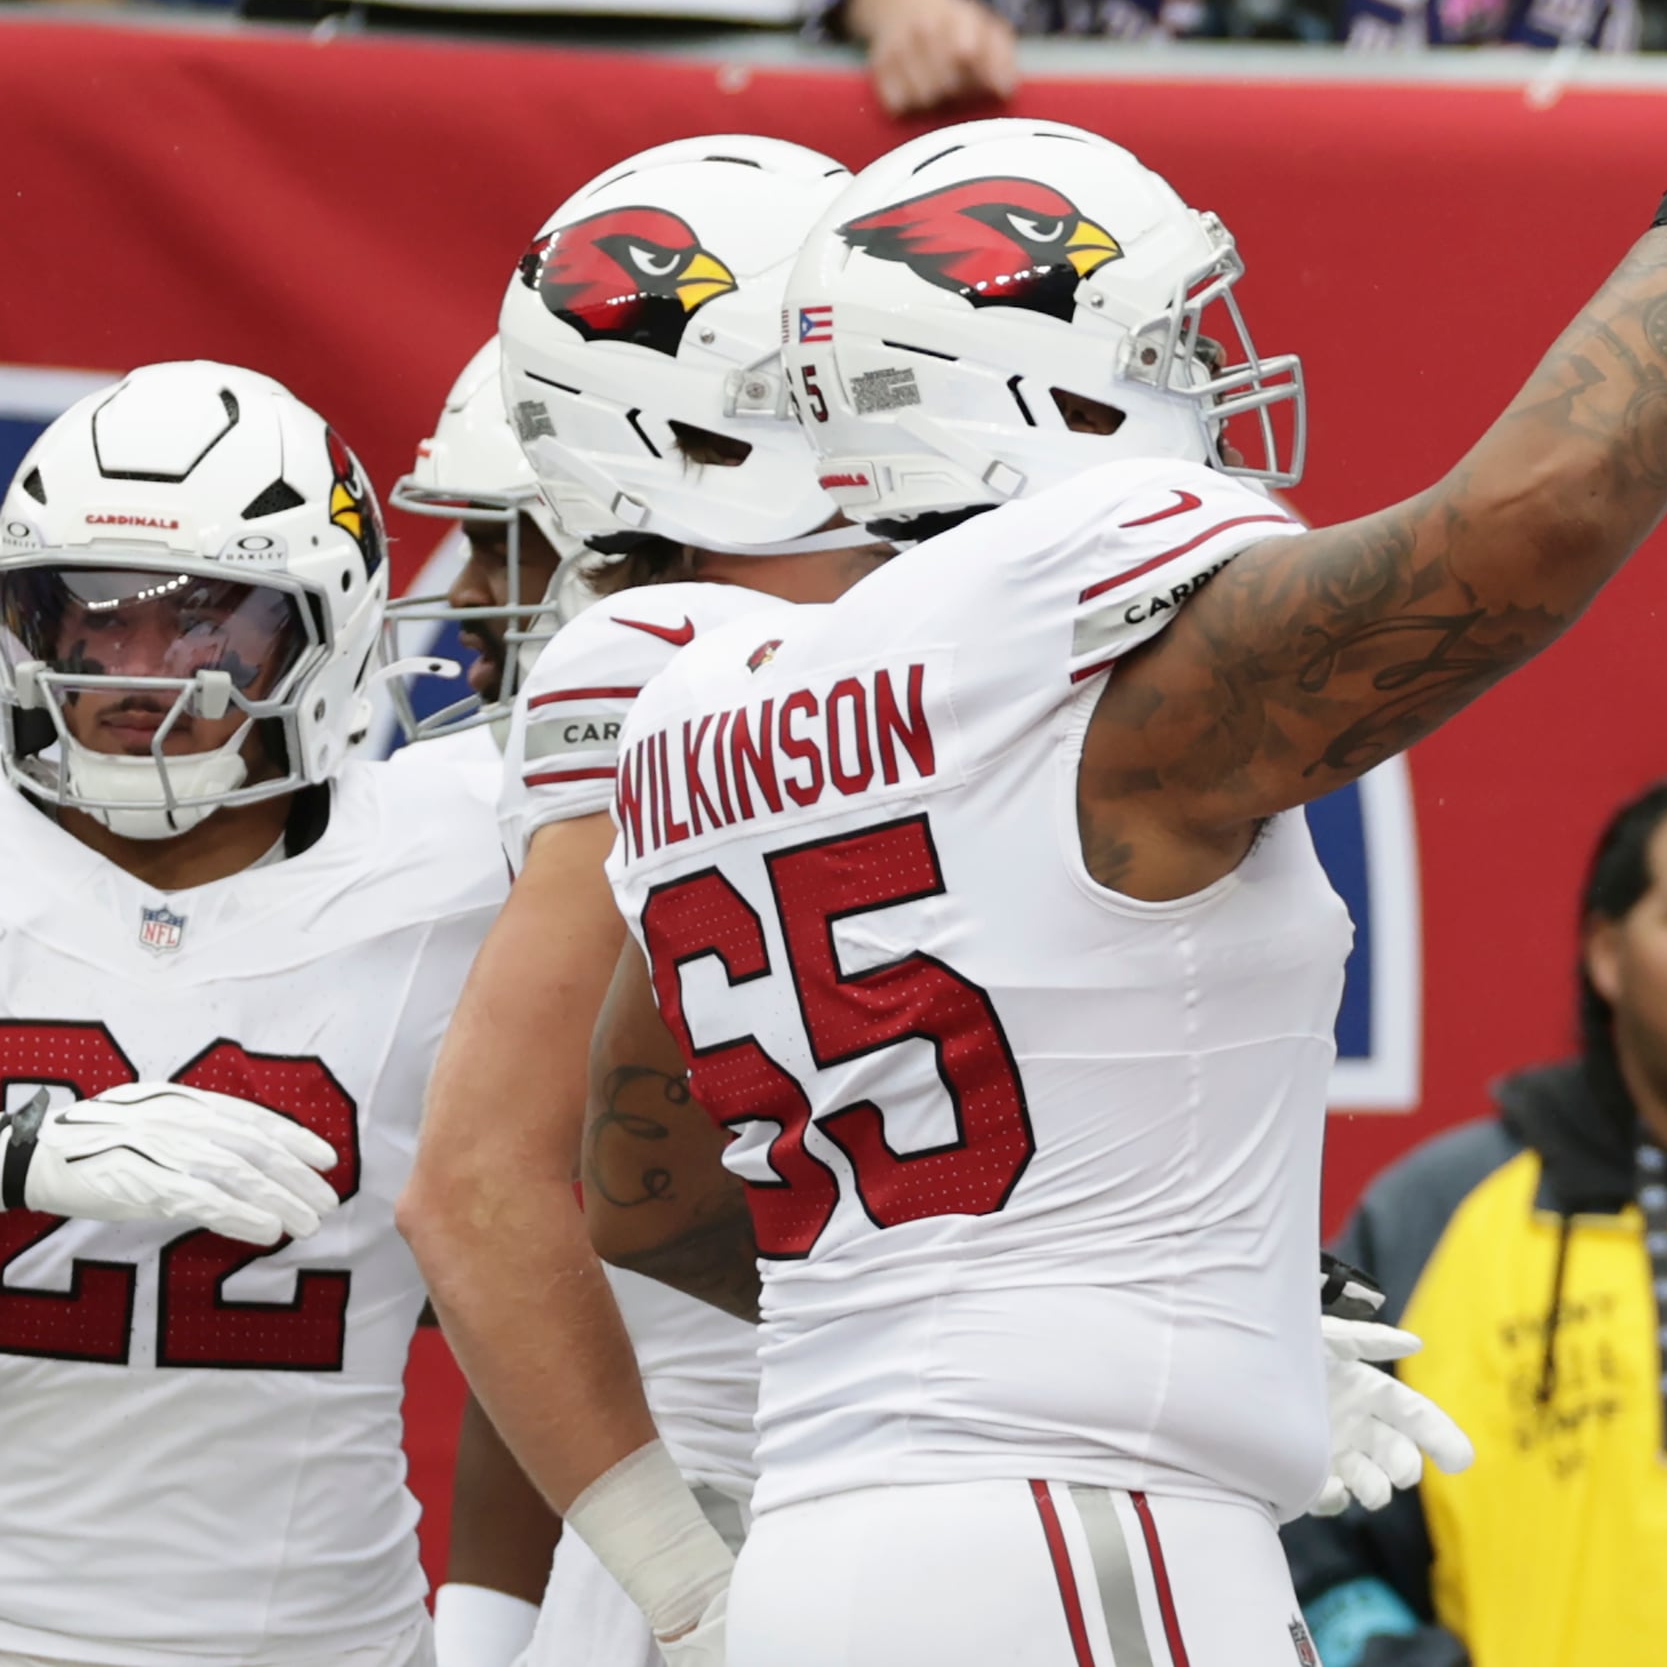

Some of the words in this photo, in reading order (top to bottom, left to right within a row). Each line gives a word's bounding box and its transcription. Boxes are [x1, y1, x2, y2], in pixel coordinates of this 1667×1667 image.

[85, 513, 180, 530] CARDINALS
[226, 552, 284, 561] OAKLEY
[1123, 552, 1240, 625] CARD
[616, 664, 936, 867] WILKINSON
[641, 812, 1037, 1261] 65
[0, 1018, 361, 1371] 22
